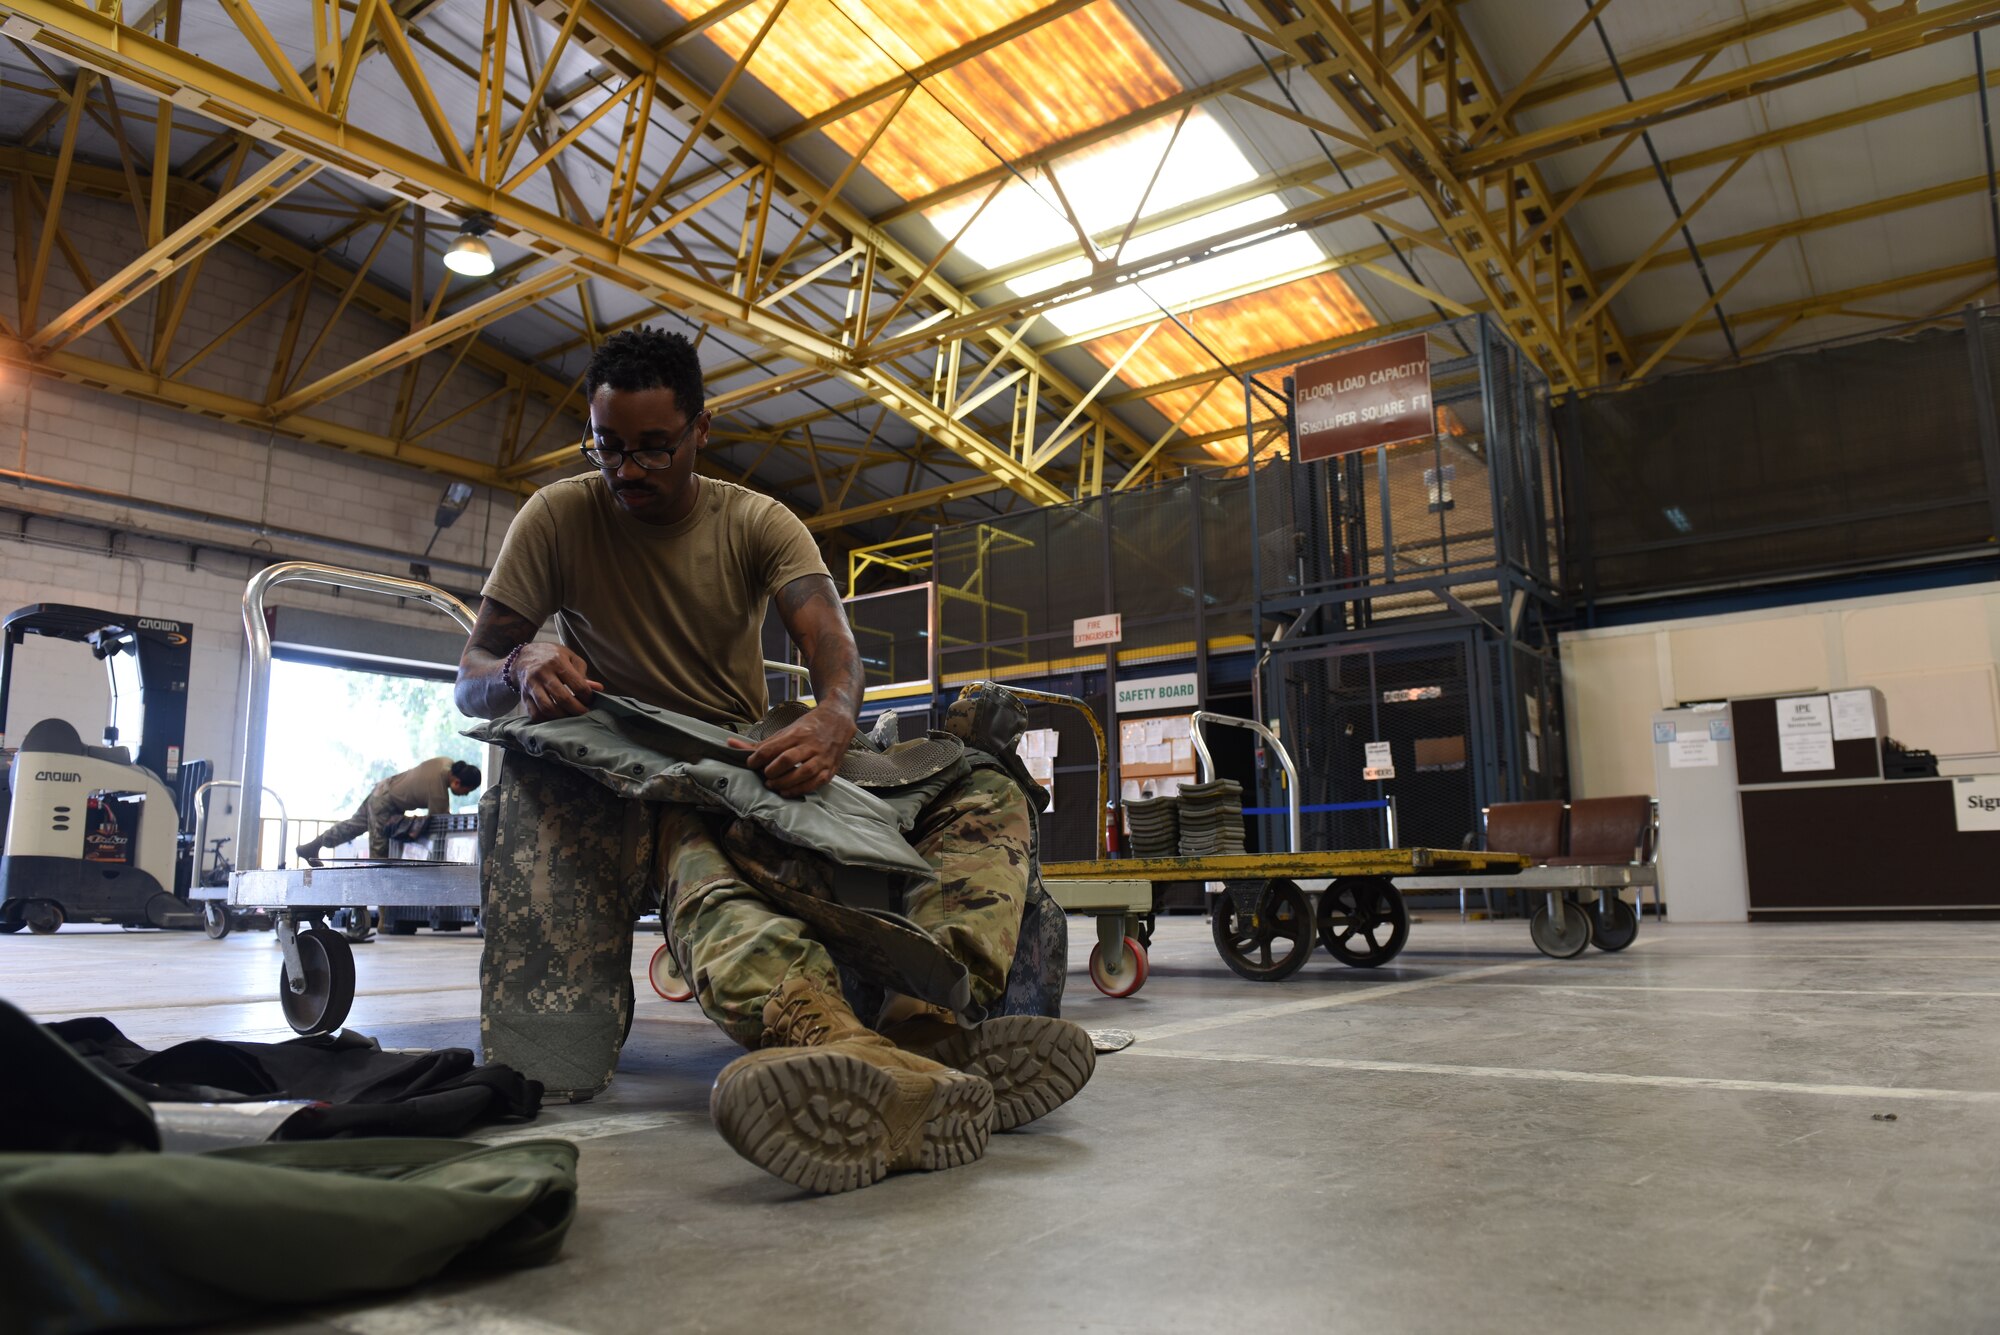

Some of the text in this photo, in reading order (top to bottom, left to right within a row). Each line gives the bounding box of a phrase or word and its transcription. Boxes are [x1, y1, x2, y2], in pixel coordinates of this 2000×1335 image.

[1299, 361, 1426, 402] FLOOR LOAD CAPACITY
[1300, 421, 1310, 436] IS
[1335, 411, 1357, 428] PER
[1361, 400, 1406, 422] SQUARE
[1412, 394, 1427, 410] FT
[137, 619, 180, 632] CROWN
[1087, 620, 1101, 629] FIRE
[1075, 630, 1114, 643] EXTINGUISHER
[1119, 684, 1194, 702] SAFETY BOARD
[35, 771, 82, 783] CROWN
